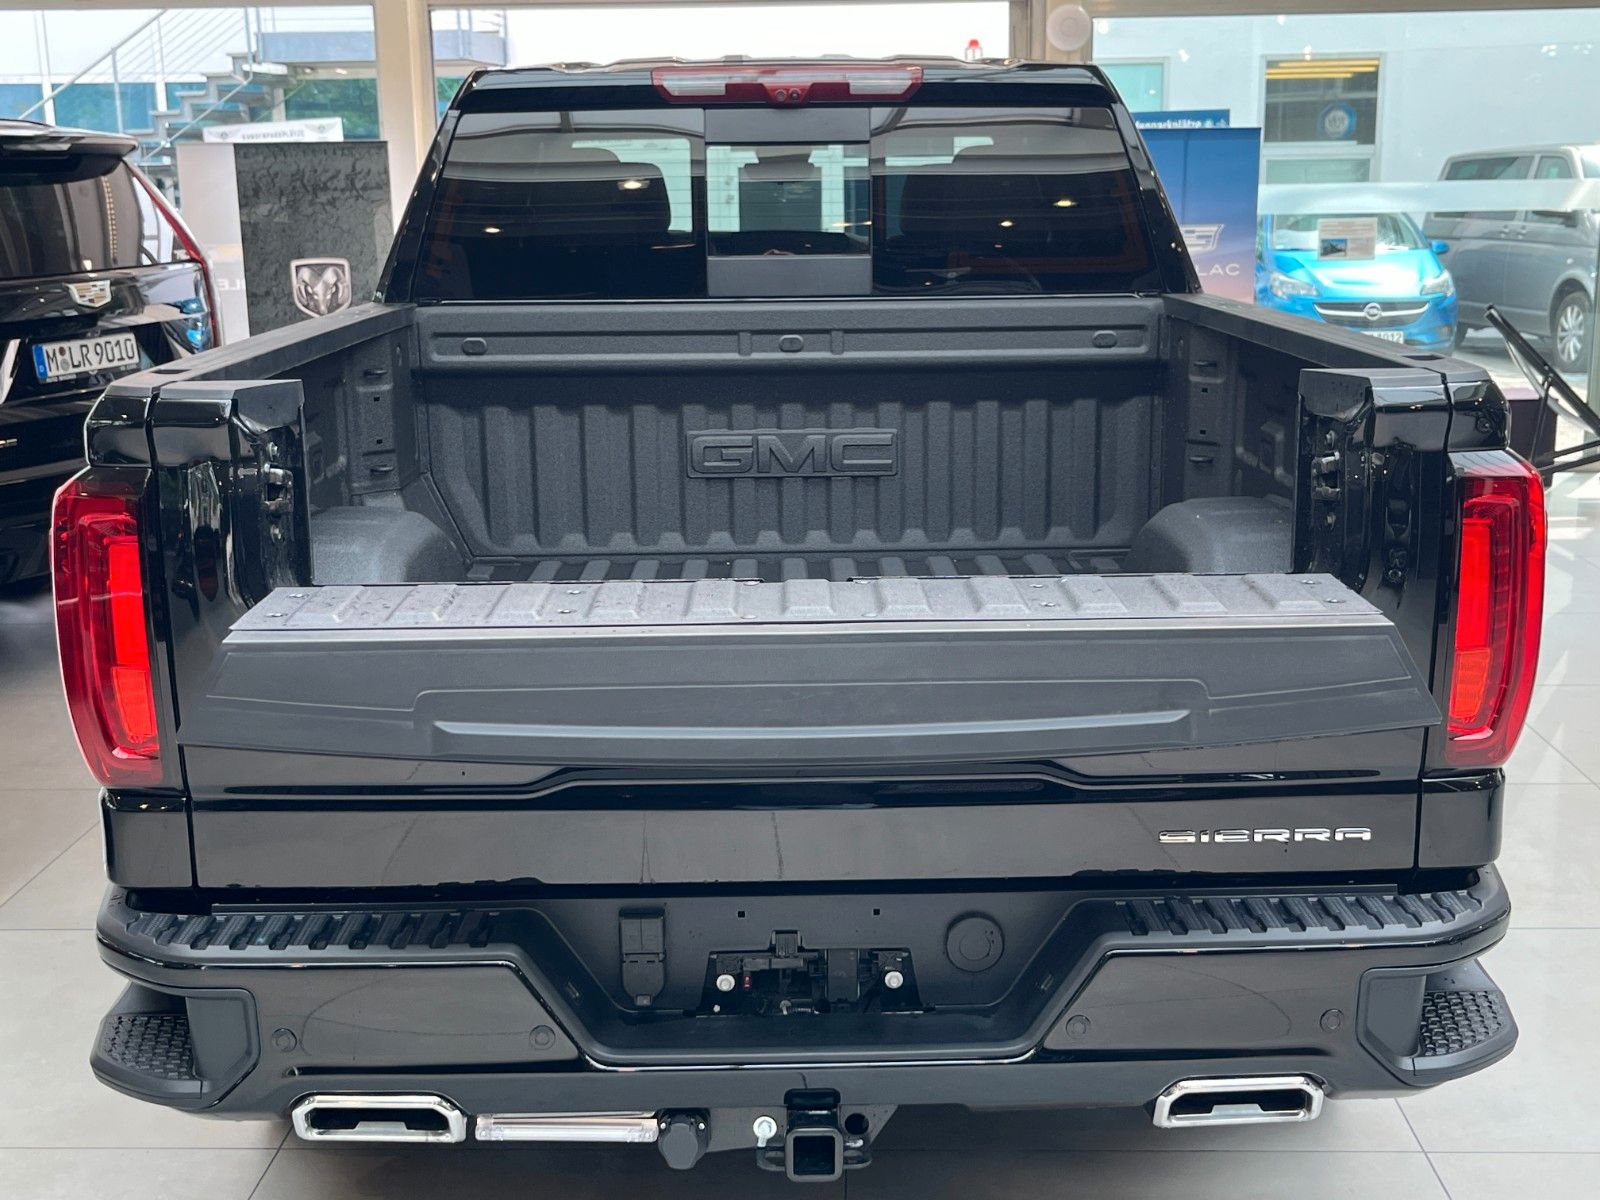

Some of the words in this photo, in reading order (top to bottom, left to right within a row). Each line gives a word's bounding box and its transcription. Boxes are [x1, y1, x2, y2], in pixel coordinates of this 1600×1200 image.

[45, 344, 60, 372] M
[68, 344, 93, 369] LR
[94, 338, 136, 365] 9010
[691, 433, 893, 474] GMC
[1158, 827, 1372, 843] SIERRA
